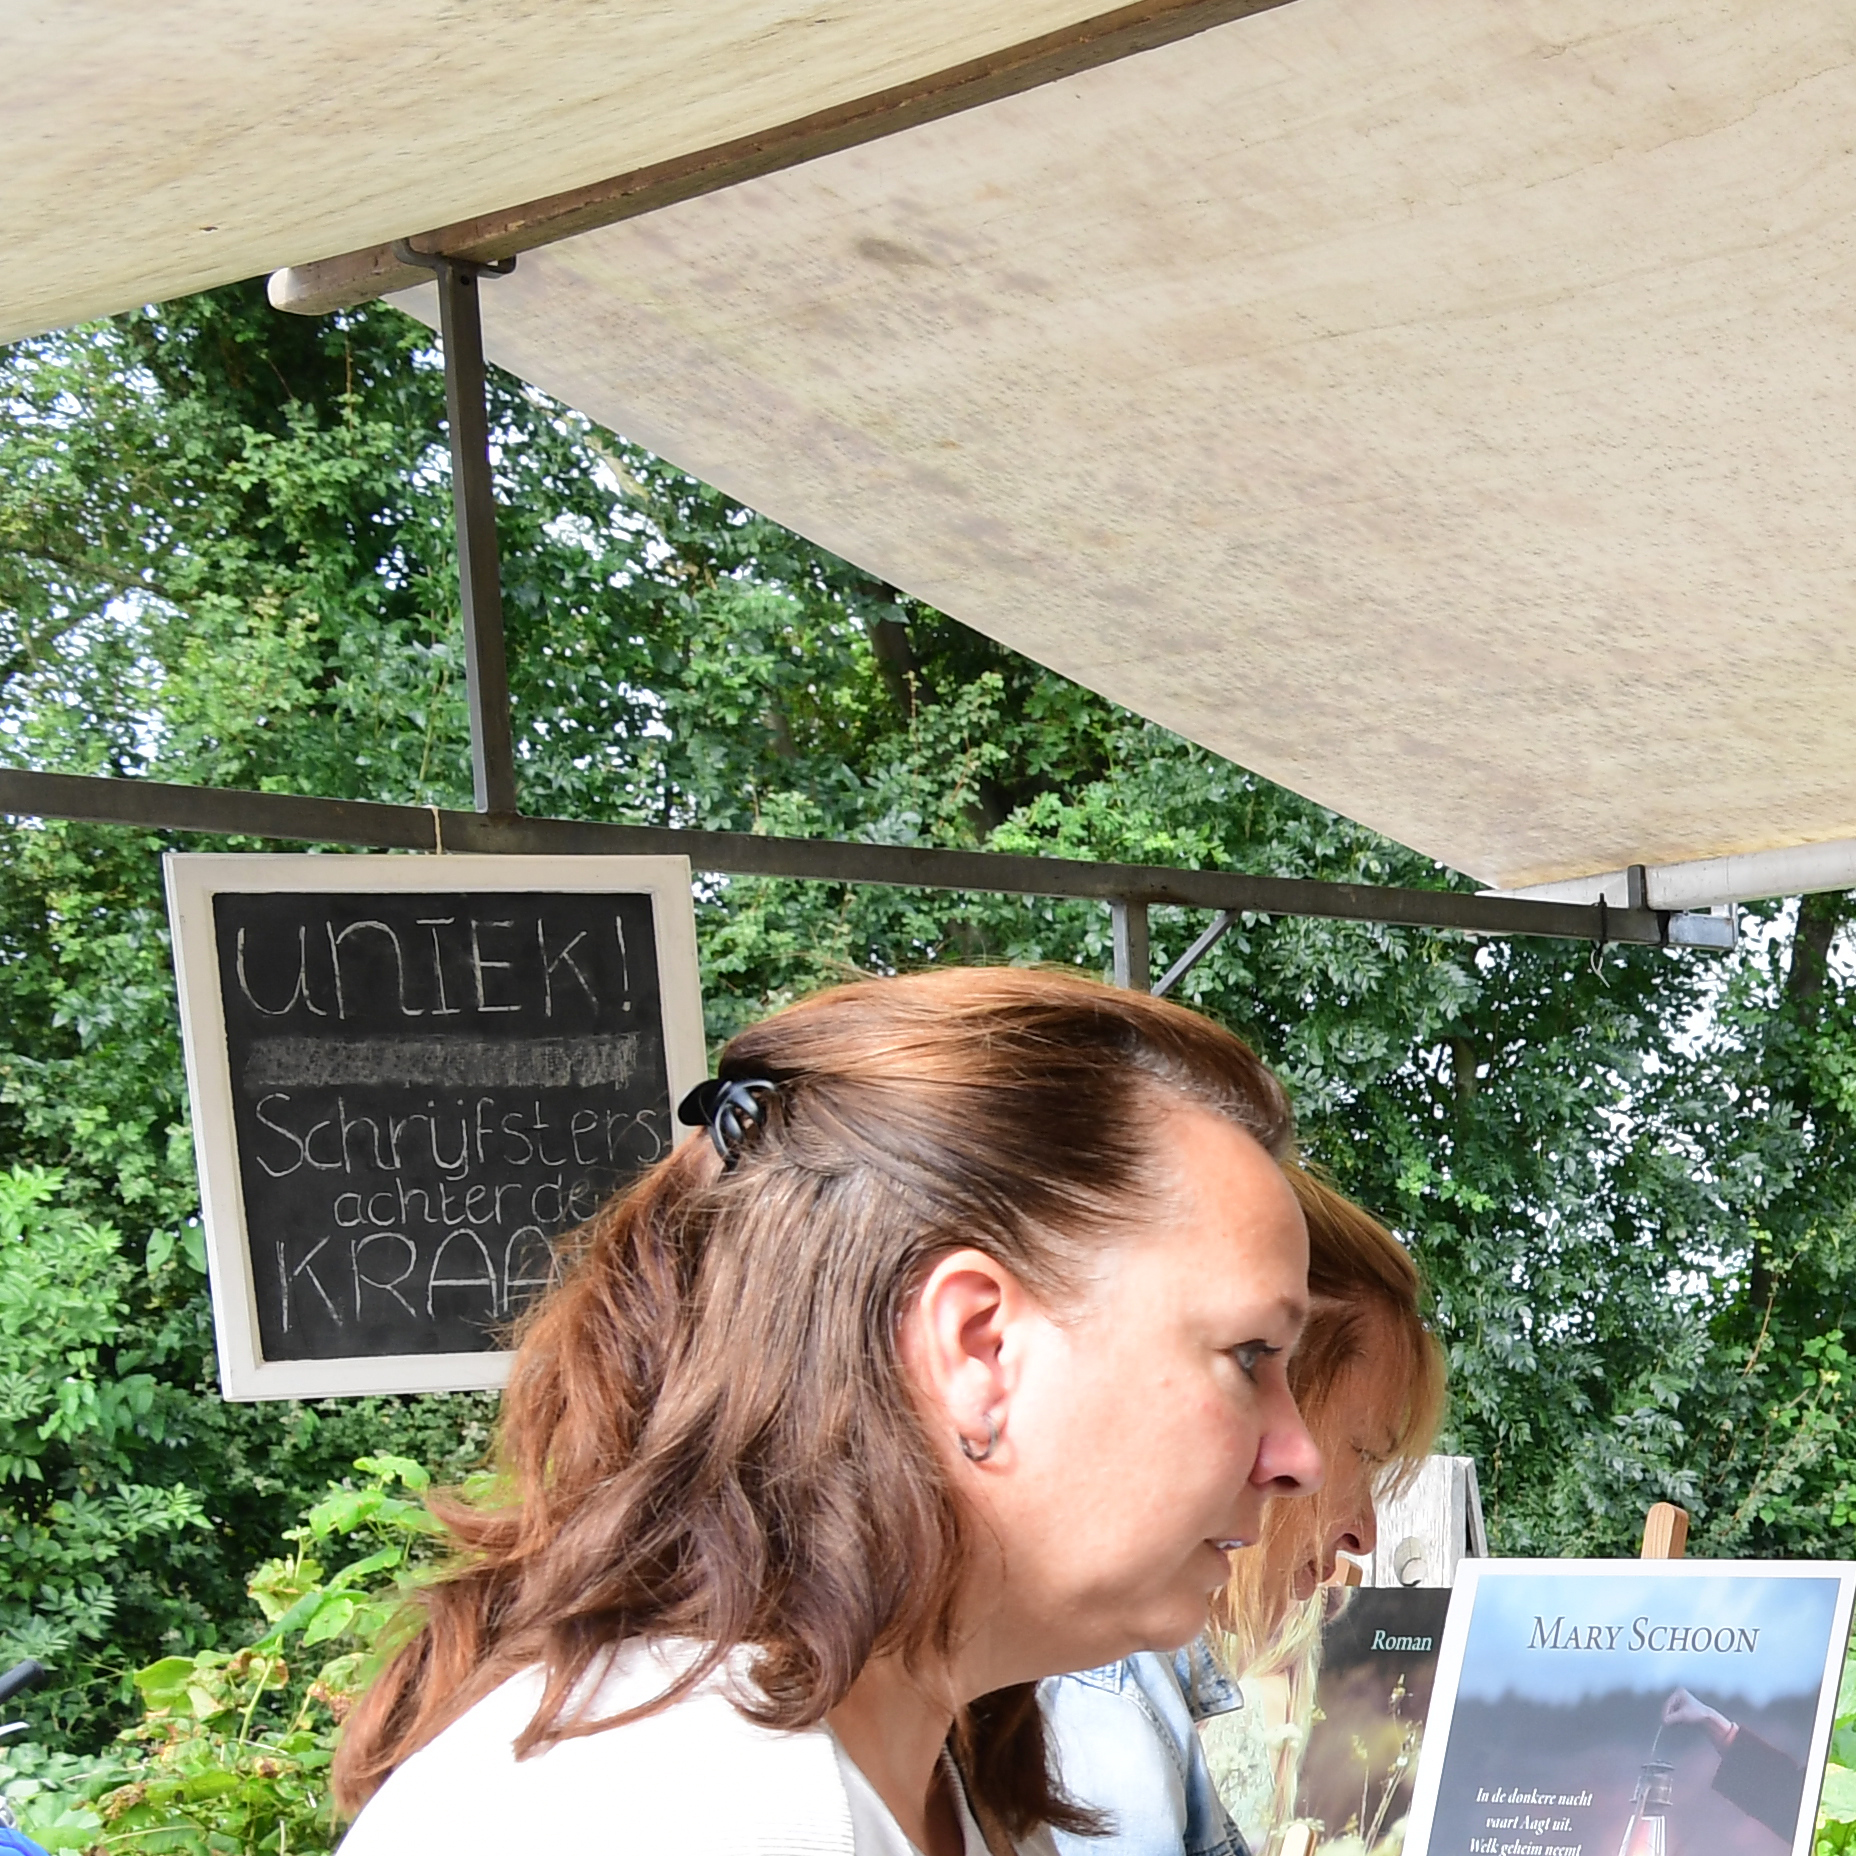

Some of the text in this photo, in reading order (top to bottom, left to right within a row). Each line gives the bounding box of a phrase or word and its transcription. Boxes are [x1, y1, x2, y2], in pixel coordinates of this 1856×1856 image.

[254, 1092, 662, 1180] Schrijfsters
[333, 1173, 598, 1228] achter de
[275, 1225, 563, 1334] KRAA
[1370, 1628, 1433, 1652] Roman
[1526, 1614, 1760, 1655] MARY SCHOON
[1475, 1786, 1594, 1807] In de donkere nacht
[1485, 1814, 1573, 1836] vaart Aagt uit.
[1469, 1837, 1499, 1854] Welk
